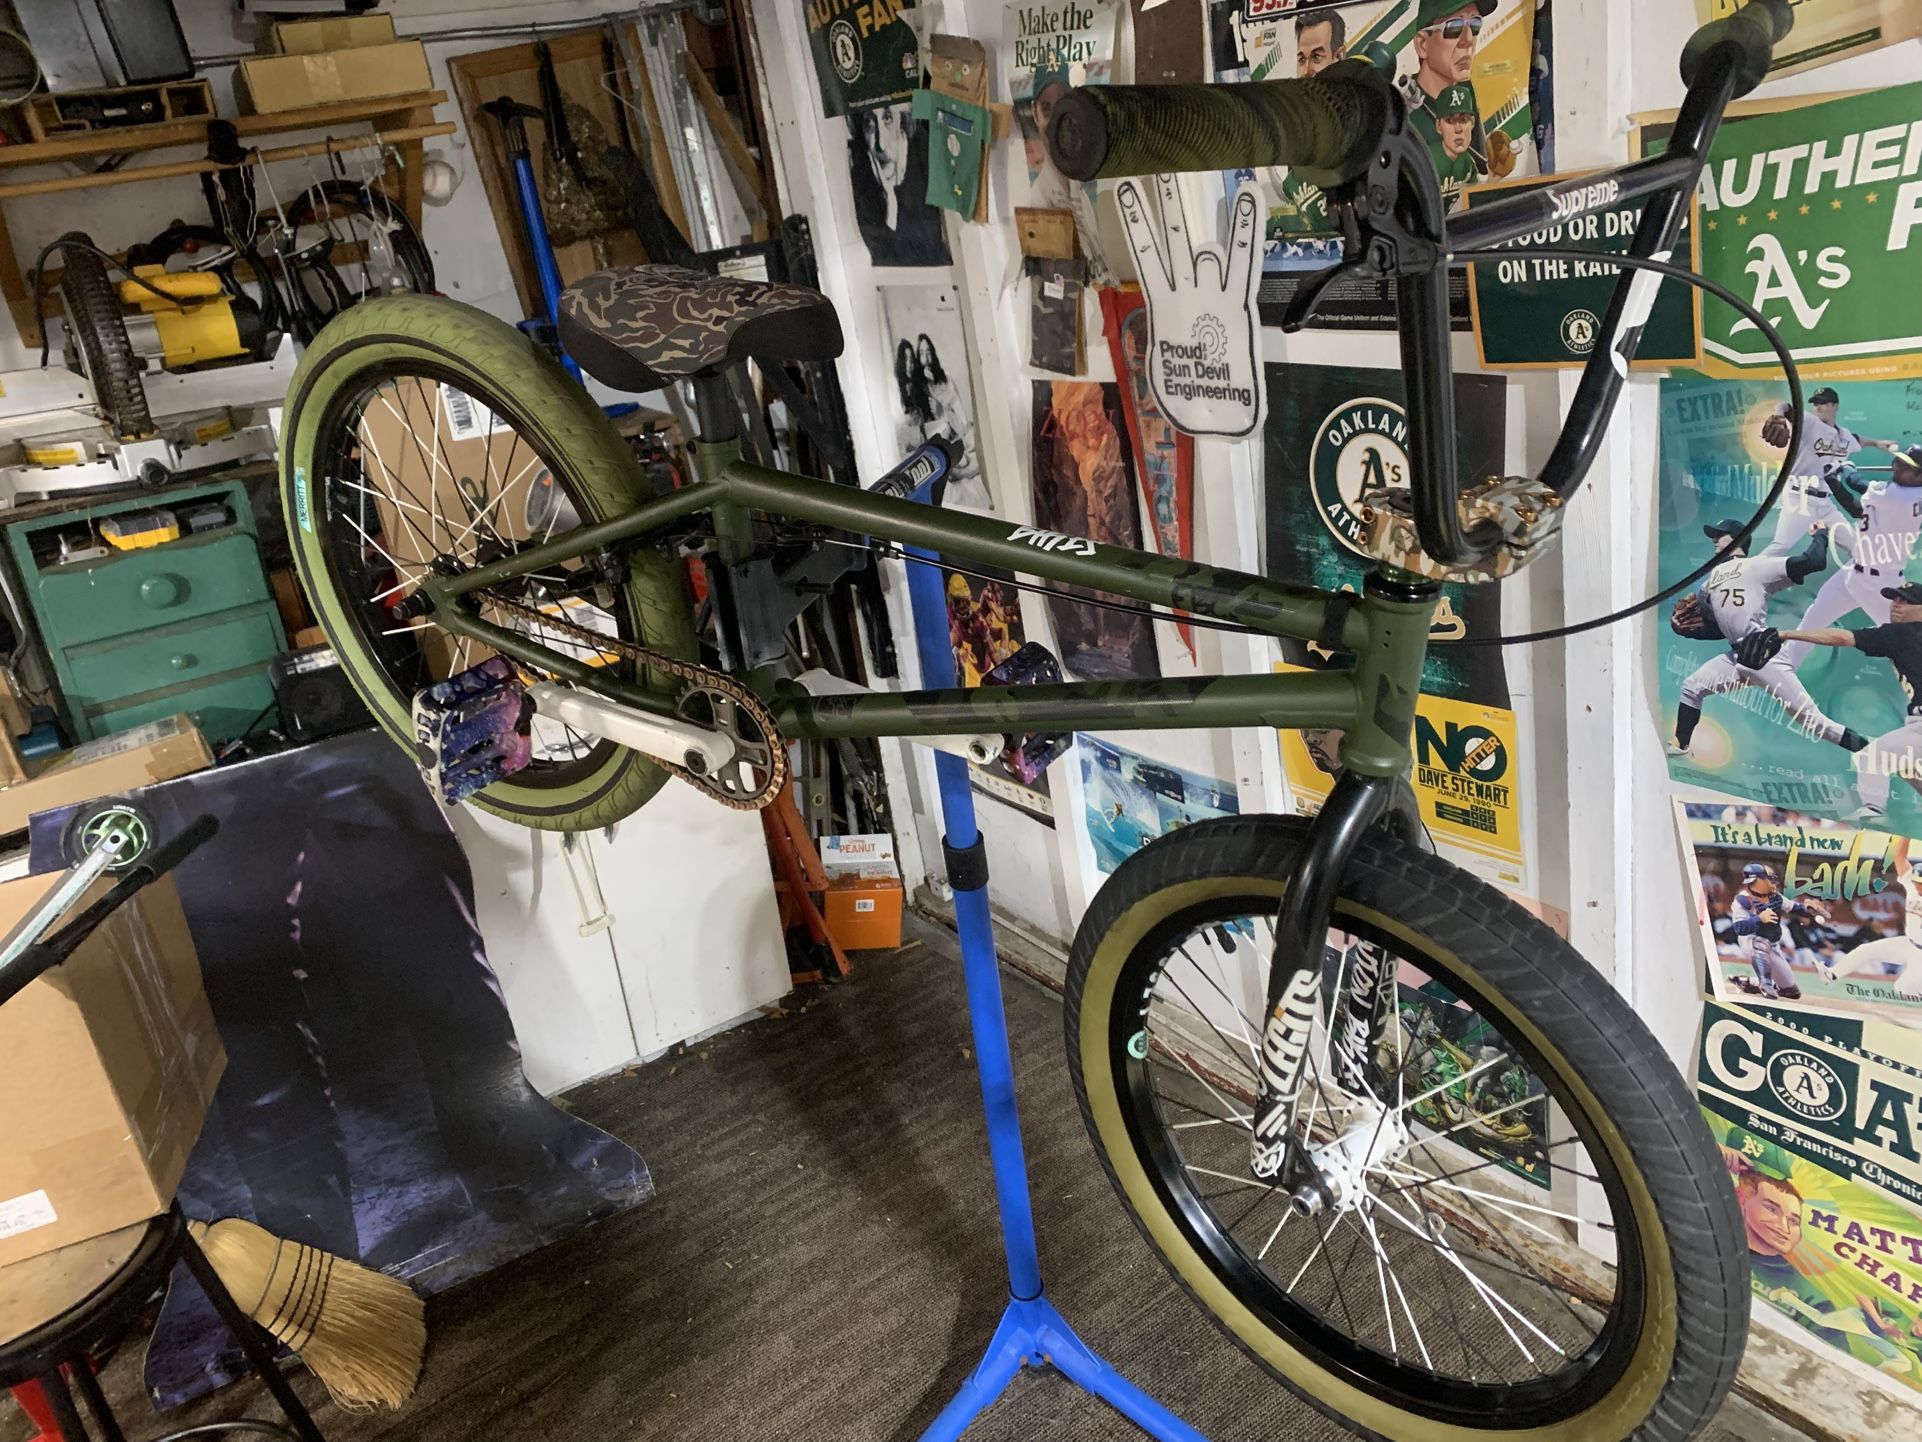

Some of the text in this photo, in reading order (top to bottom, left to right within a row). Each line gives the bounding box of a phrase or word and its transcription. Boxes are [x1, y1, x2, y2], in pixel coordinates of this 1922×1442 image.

[1018, 2, 1094, 37] Make the
[1015, 34, 1097, 68] Right Play
[1547, 178, 1619, 222] Supreme
[1568, 214, 1598, 241] OR
[1498, 259, 1527, 284] ON
[1532, 258, 1568, 281] THE
[1729, 233, 1851, 337] A's
[1159, 340, 1203, 360] Proud
[1162, 359, 1231, 381] Sun Devil
[1163, 378, 1252, 407] Engineering
[1676, 388, 1745, 423] EXTRA!
[1328, 409, 1410, 451] OAKLAN
[296, 484, 308, 522] MERRITT
[1719, 588, 1746, 609] 75
[1415, 714, 1508, 783] NO
[1460, 735, 1502, 772] HITTER
[1418, 766, 1510, 806] DAVE STEWART
[1436, 788, 1458, 800] JUNE
[1761, 780, 1832, 805] EXTRA!
[840, 842, 876, 854] PEANUT
[1709, 822, 1844, 851] It's a brand new
[1845, 983, 1871, 998] The
[1765, 1011, 1809, 1036] 2000
[1780, 1055, 1835, 1084] OAKLAND
[1793, 1071, 1823, 1100] A's
[1775, 1086, 1835, 1117] ATHLETICS
[1740, 1135, 1765, 1158] A's
[1747, 1113, 1778, 1136] San
[1780, 1125, 1857, 1168] Francisco
